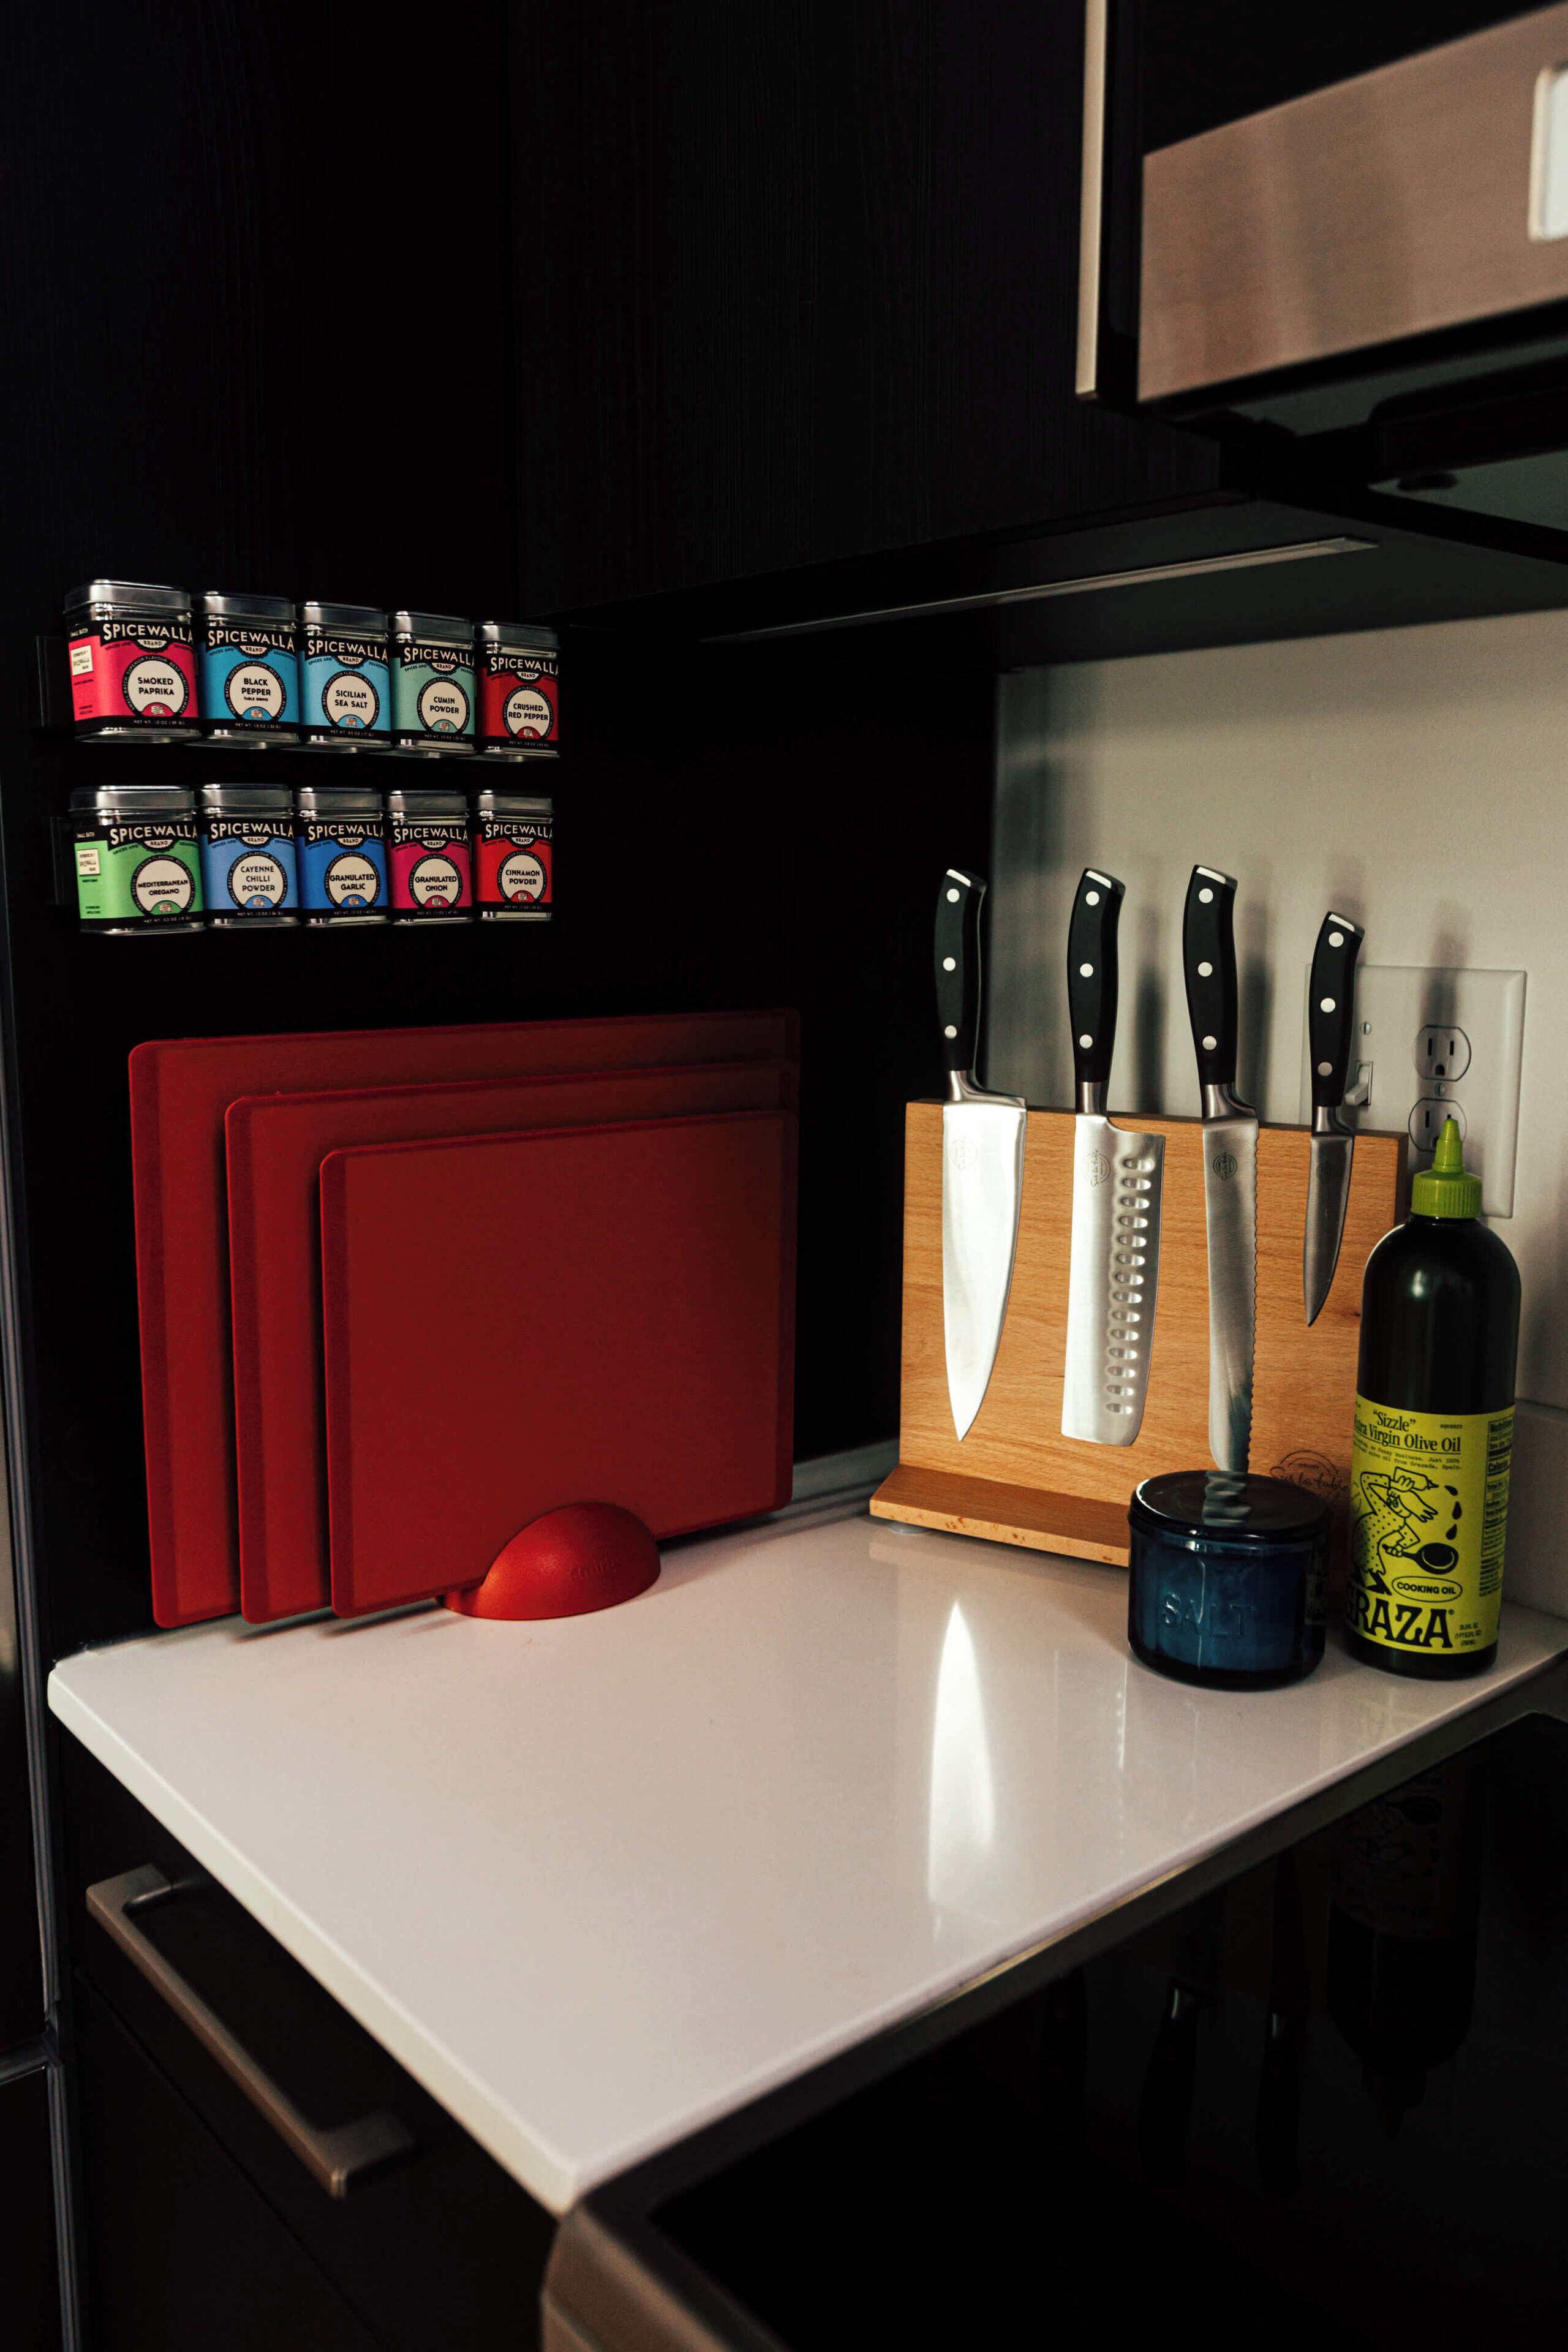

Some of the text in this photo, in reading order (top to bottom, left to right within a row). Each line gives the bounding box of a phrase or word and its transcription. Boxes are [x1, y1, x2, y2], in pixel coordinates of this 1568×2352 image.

[103, 624, 193, 643] SPICEWALLA
[208, 630, 295, 652] SPICEWALLA
[308, 639, 388, 663] SPICEWALLA
[138, 677, 173, 685] SMOKED
[336, 690, 367, 699] SICILIAN
[110, 825, 197, 845] SPICEWALLA
[210, 823, 295, 839] SPICEWALLA
[308, 824, 383, 841] SPICEWALLA
[394, 828, 468, 843] SPICEWALLA
[1373, 1410, 1416, 1432] “Sizzle”
[1370, 1424, 1400, 1446] Virgin
[1404, 1434, 1438, 1451] Olive
[1441, 1437, 1461, 1452] Oil
[1397, 1582, 1439, 1594] COOKING
[1162, 1593, 1256, 1638] SALT
